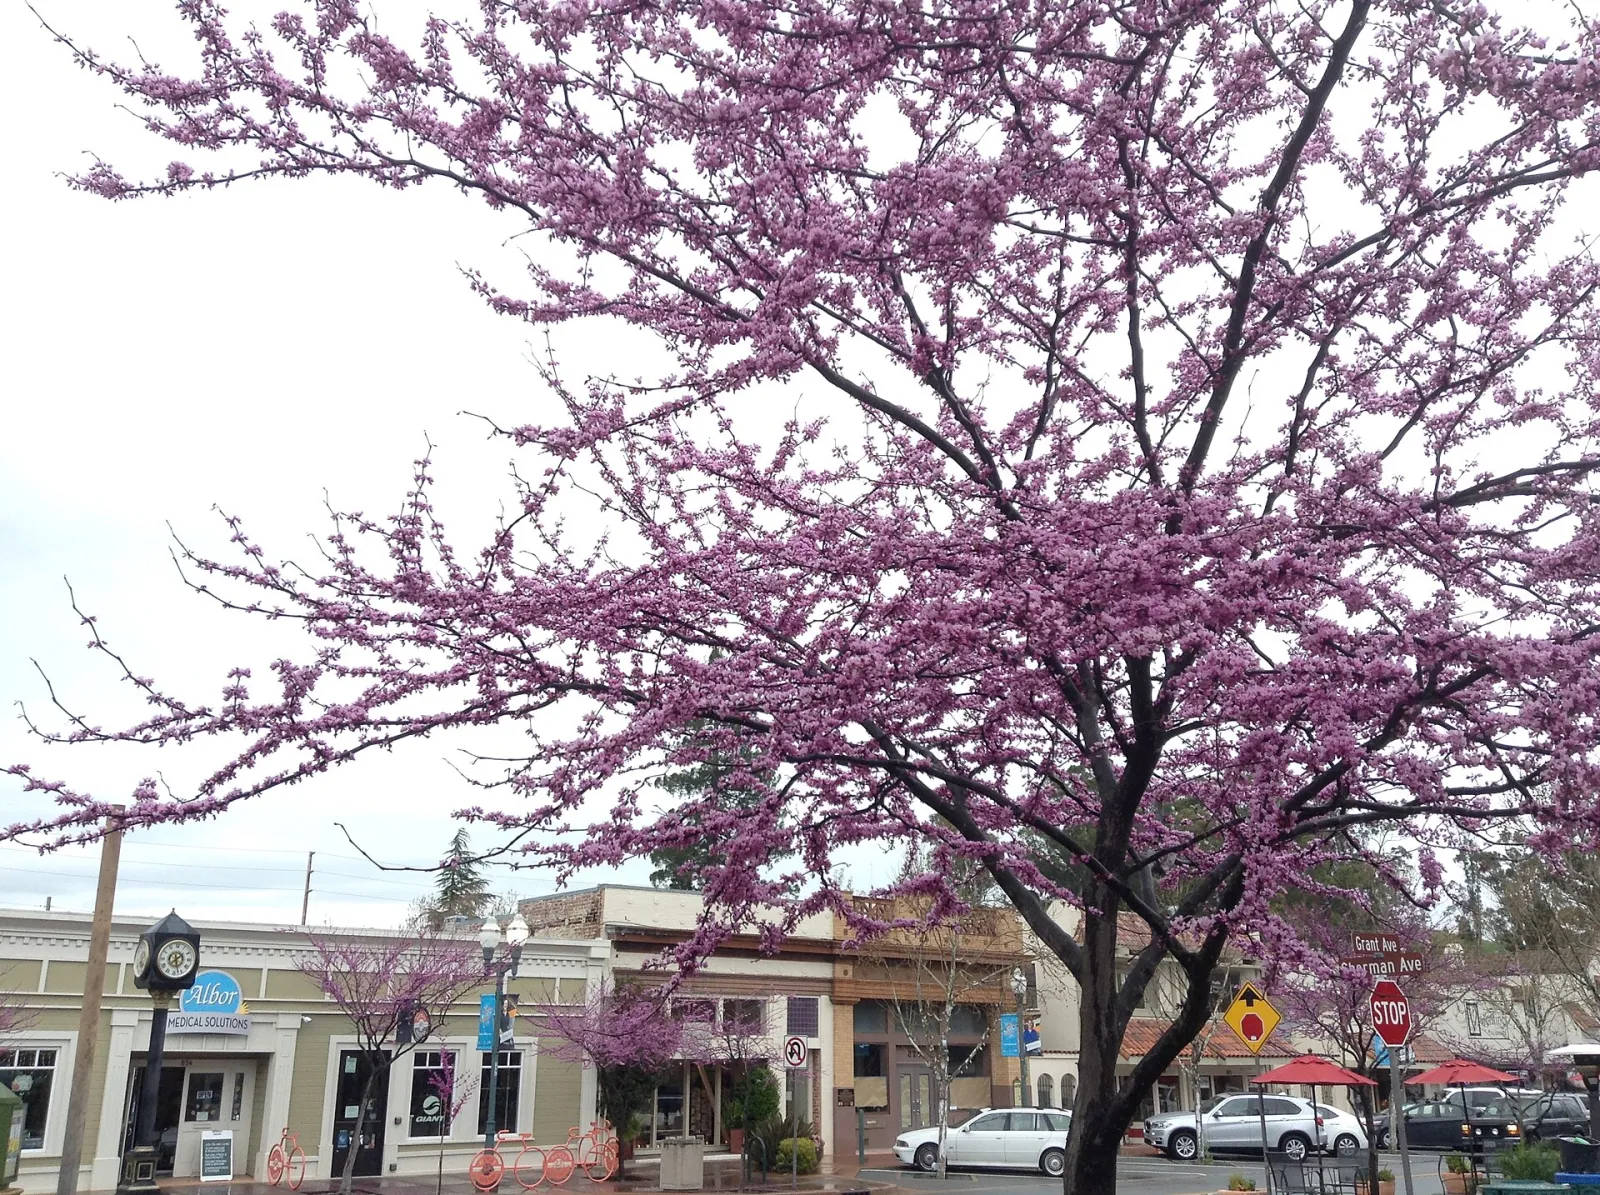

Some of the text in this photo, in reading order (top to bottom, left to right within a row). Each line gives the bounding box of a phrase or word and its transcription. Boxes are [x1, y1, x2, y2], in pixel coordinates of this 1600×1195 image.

[1355, 936, 1397, 952] Grant Ave
[1400, 956, 1422, 972] Ave
[185, 982, 238, 1005] Albor
[1373, 1001, 1407, 1025] STOP
[167, 1016, 248, 1030] MEDICAL SOLUTIONS
[415, 1115, 445, 1123] GIANT
